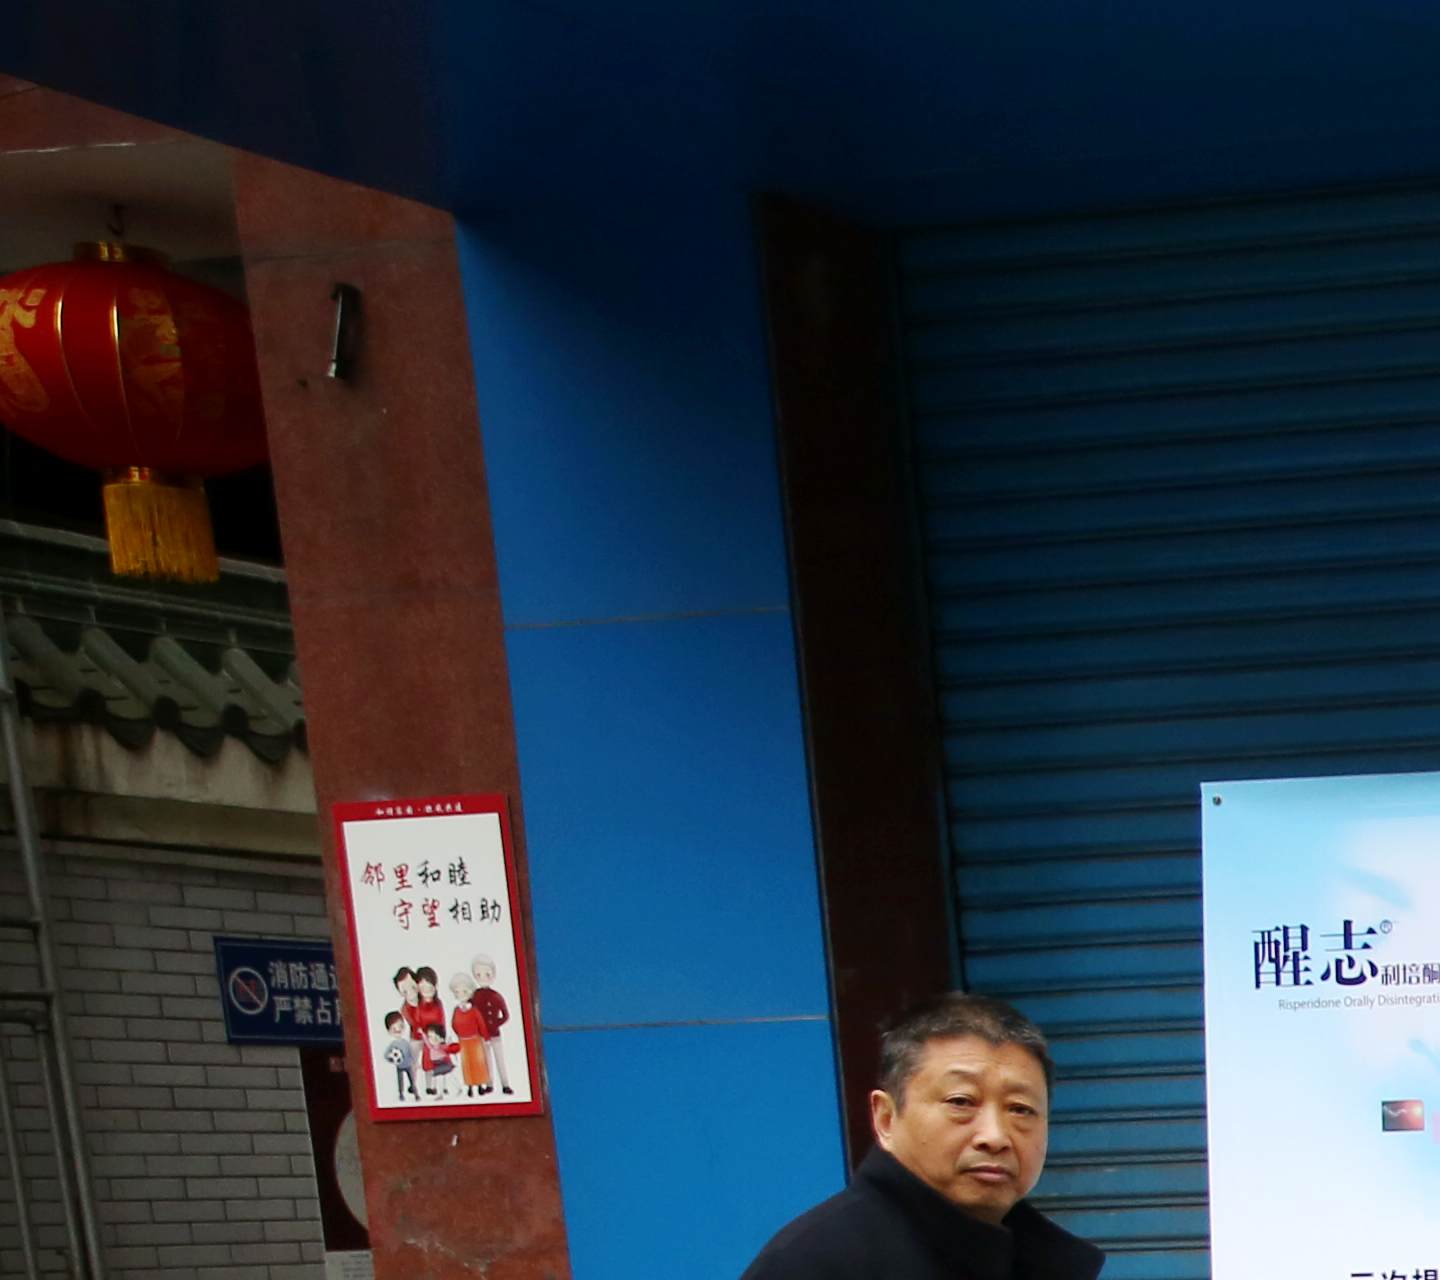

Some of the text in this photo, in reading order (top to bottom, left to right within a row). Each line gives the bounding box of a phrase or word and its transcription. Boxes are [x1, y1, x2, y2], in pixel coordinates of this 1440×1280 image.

[362, 856, 472, 892] 邻里和睦
[392, 898, 502, 931] 守望相助
[1252, 919, 1378, 989] 醒志
[1343, 995, 1375, 1009] Orally
